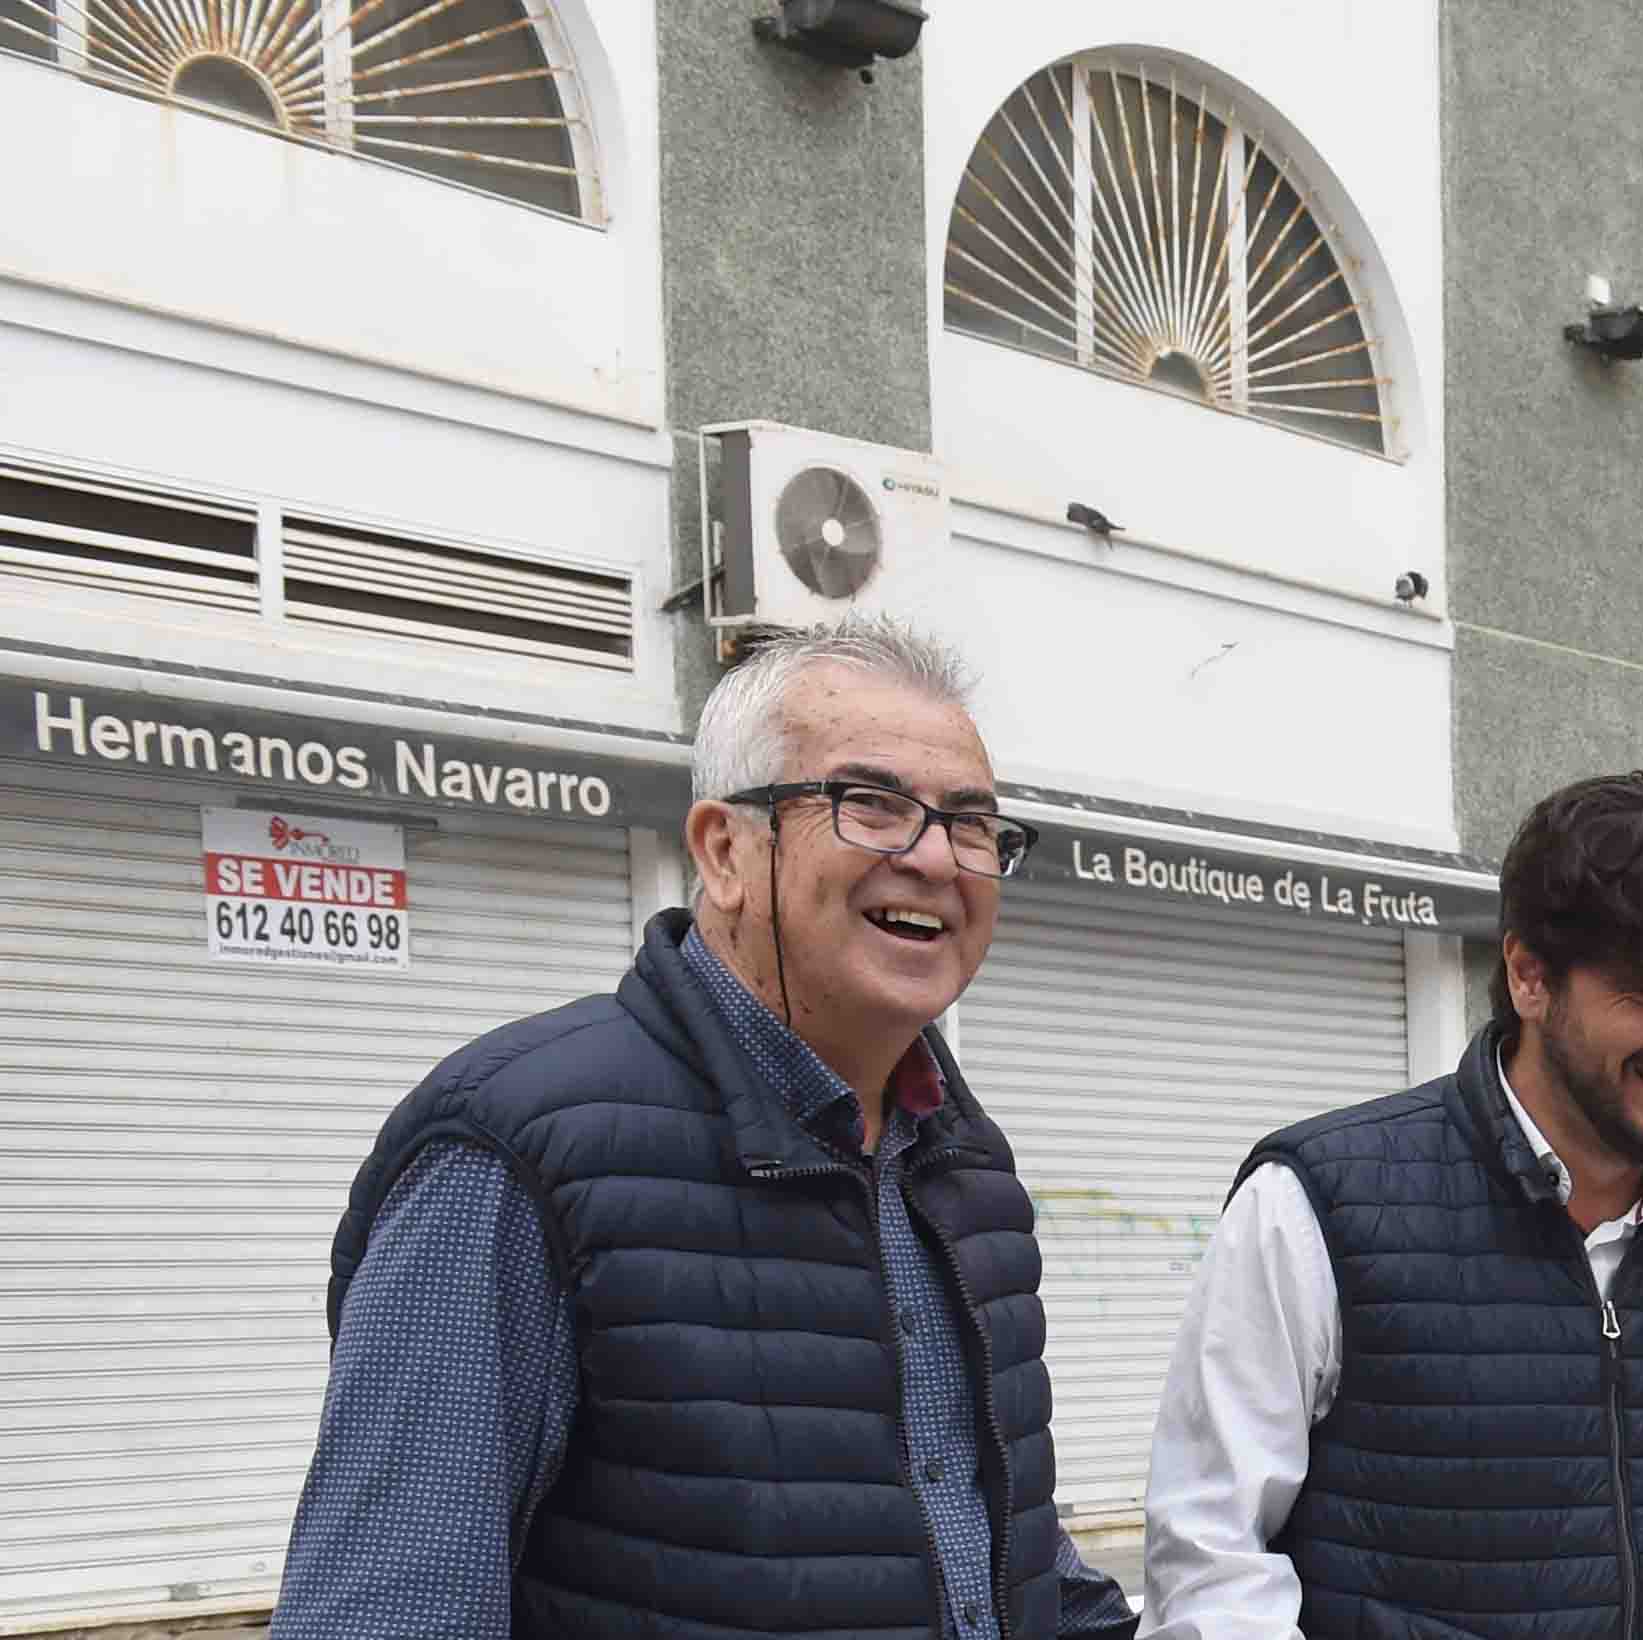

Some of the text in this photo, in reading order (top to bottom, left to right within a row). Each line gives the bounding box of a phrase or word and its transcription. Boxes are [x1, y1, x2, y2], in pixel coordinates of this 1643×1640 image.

[35, 691, 611, 817] Hermanos Navarro
[217, 857, 396, 906] SE VENDE
[1072, 840, 1440, 926] La Boutique de La Fruta
[216, 901, 401, 951] 612 40 66 98
